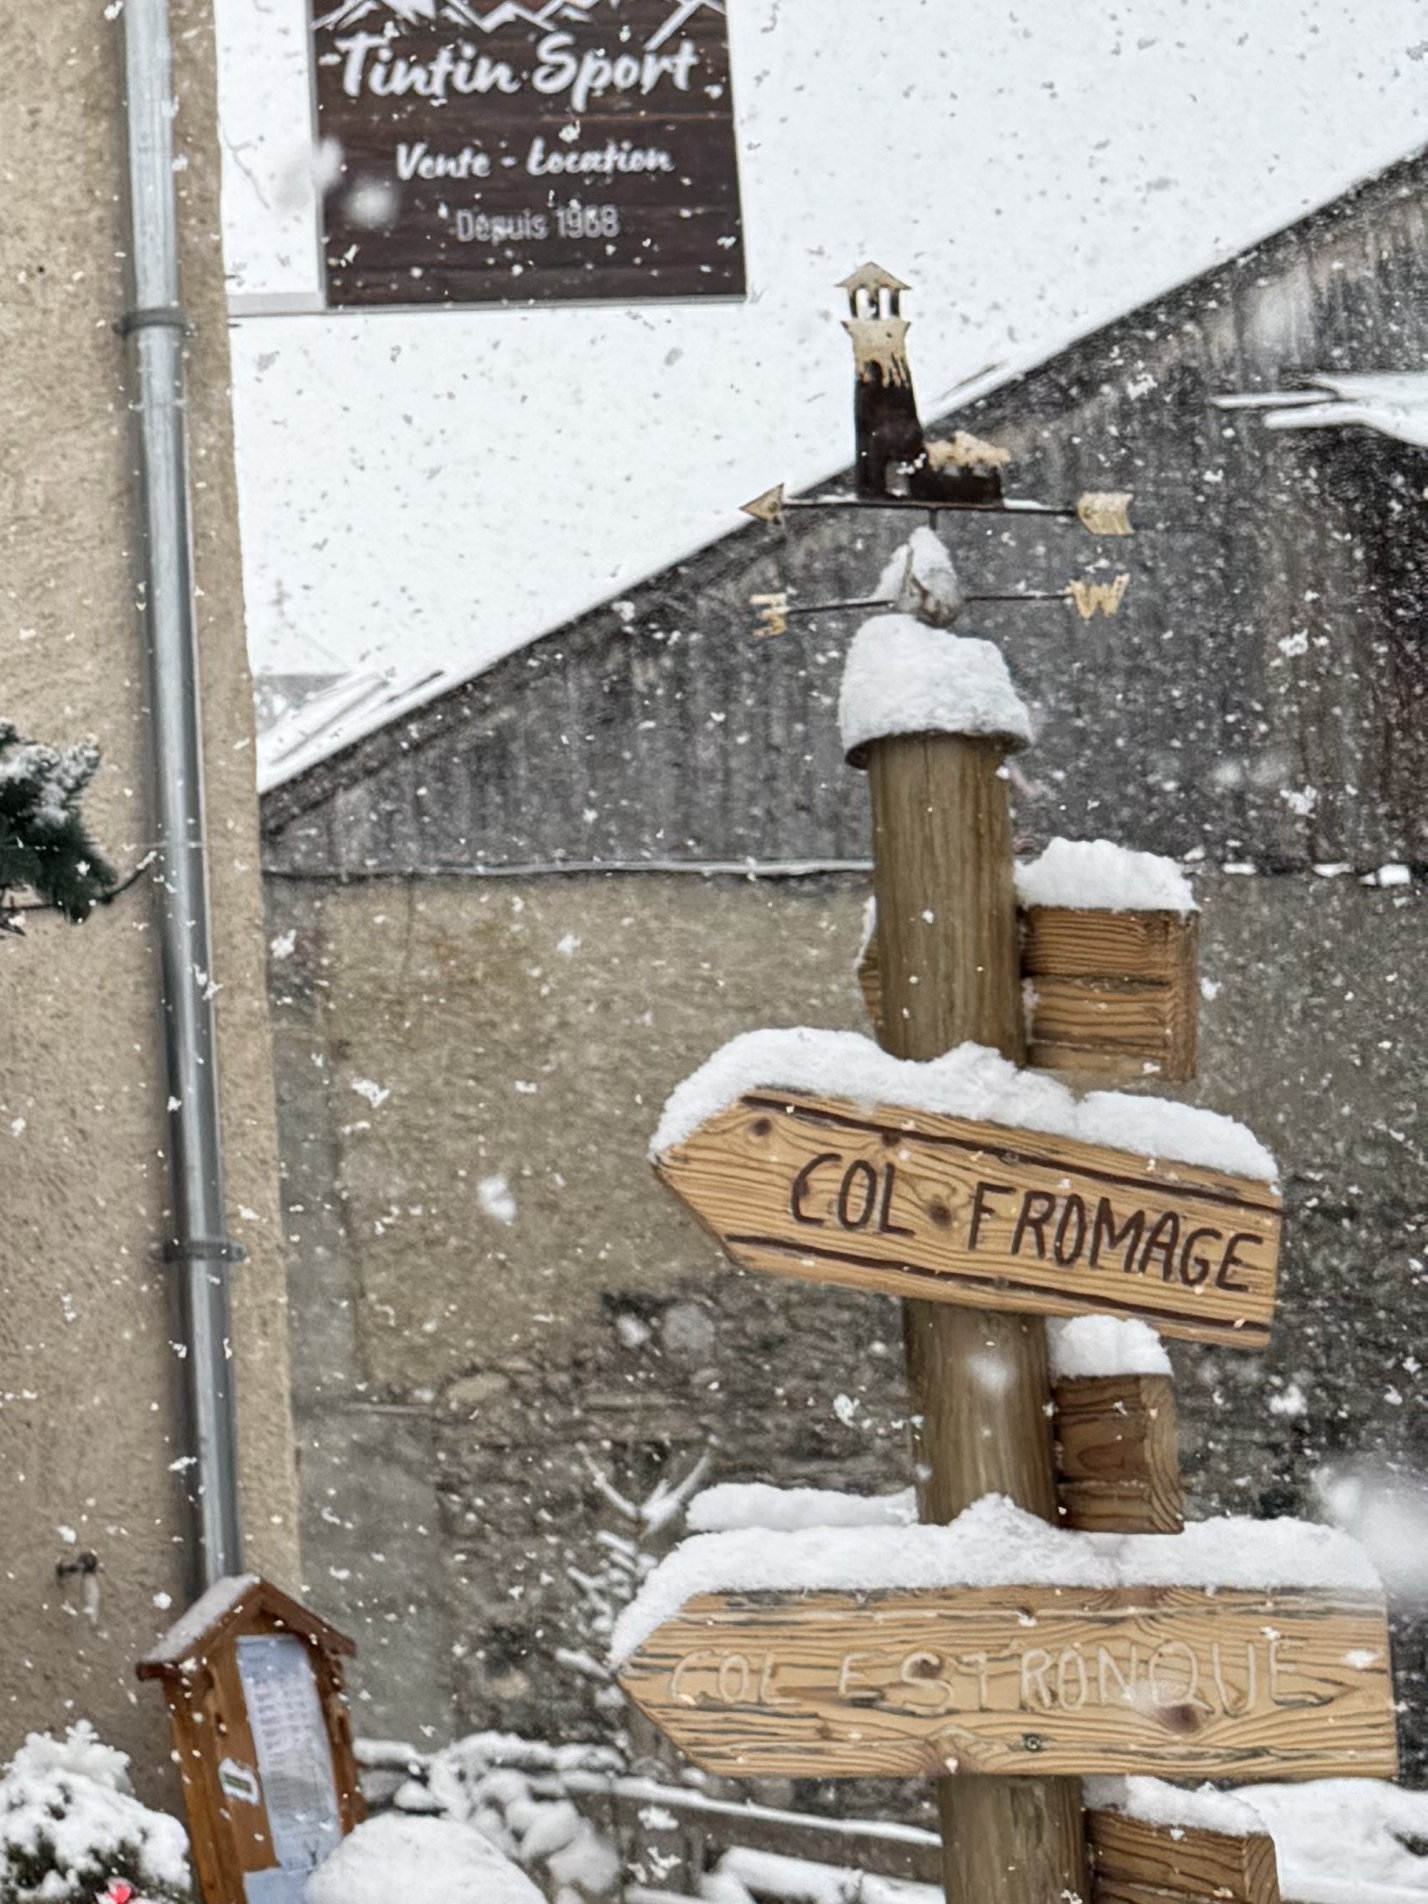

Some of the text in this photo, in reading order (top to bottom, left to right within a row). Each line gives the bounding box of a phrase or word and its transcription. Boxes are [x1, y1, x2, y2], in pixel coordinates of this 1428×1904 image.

[334, 31, 702, 113] Tintin Sport
[396, 142, 491, 180] Vente
[526, 137, 676, 176] Location
[455, 203, 622, 245] Depuis 1968
[791, 1152, 1265, 1294] COL FROMAGE
[669, 1646, 800, 1706] COL
